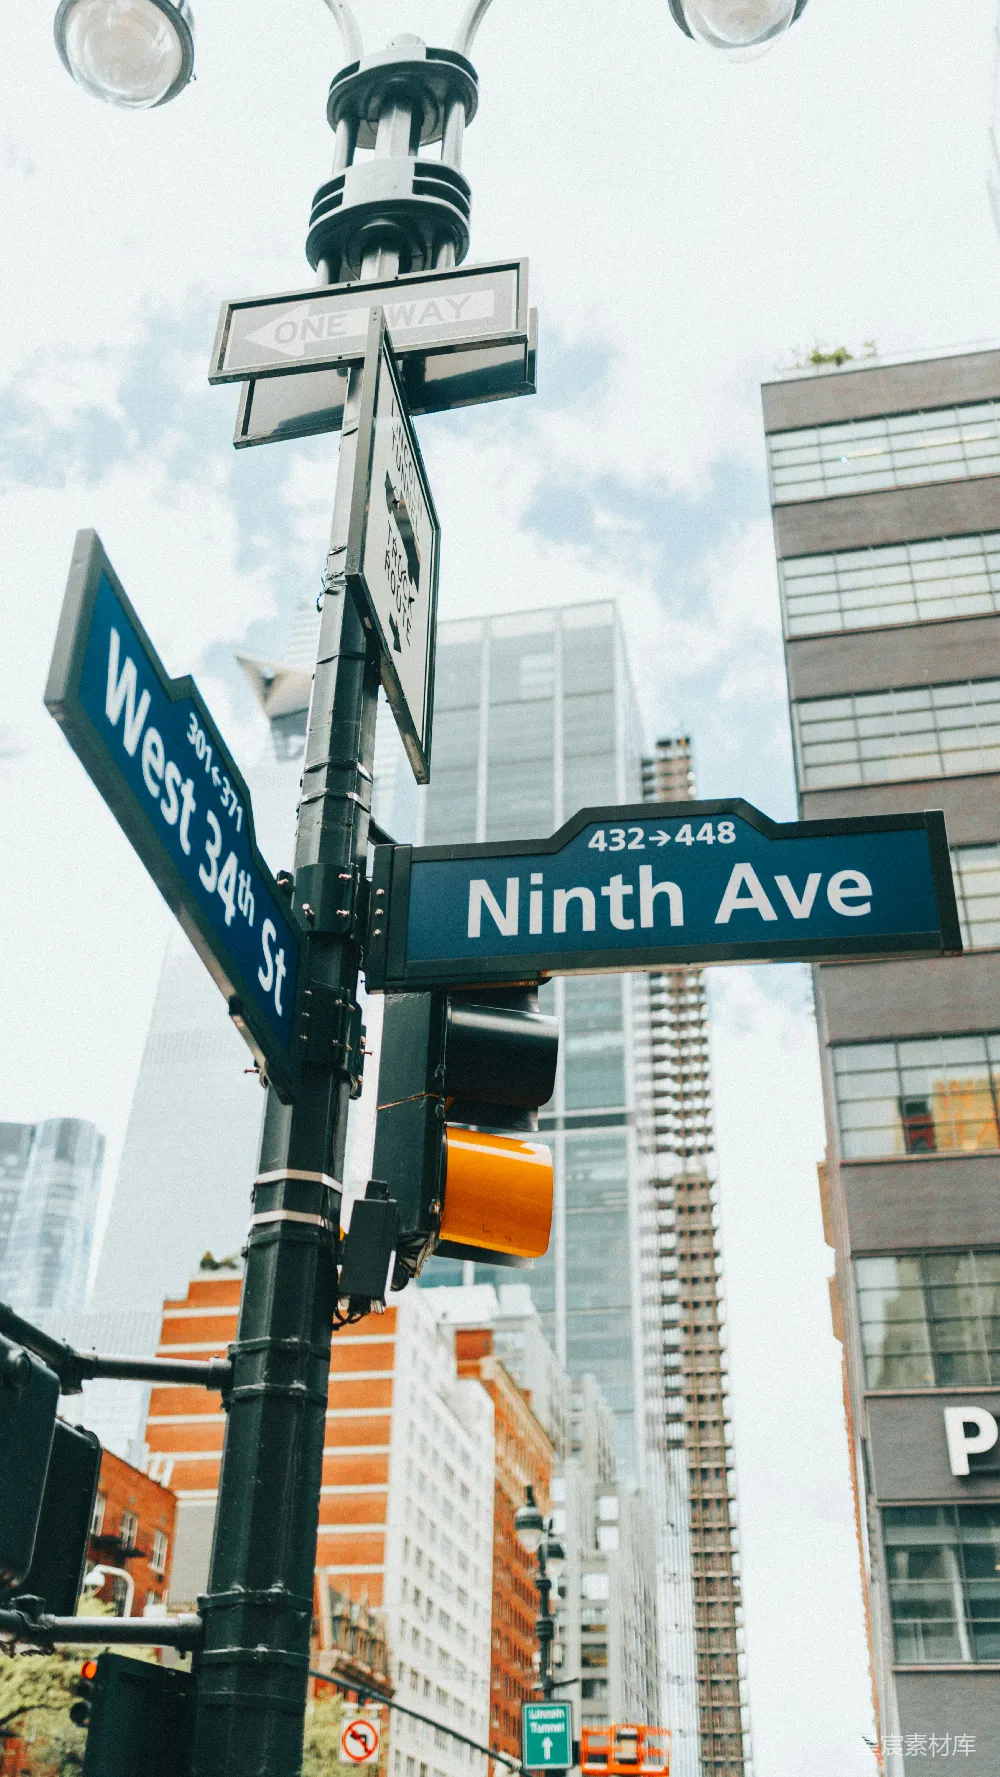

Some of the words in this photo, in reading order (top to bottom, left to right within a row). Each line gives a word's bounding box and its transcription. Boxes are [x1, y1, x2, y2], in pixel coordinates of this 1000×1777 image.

[275, 312, 347, 344] ONE
[388, 294, 471, 328] WAY
[384, 548, 411, 648] ROUTE
[387, 519, 413, 621] TRUCK
[186, 712, 213, 773] 301
[219, 776, 243, 833] 371
[105, 626, 197, 856] West
[199, 810, 255, 928] 34th
[258, 917, 287, 1018] St
[588, 827, 646, 852] 432
[674, 821, 737, 846] 448
[467, 864, 685, 938] Ninth
[714, 862, 874, 925] Ave
[943, 1406, 999, 1476] P
[528, 1708, 565, 1719] Lincoln
[529, 1722, 565, 1733] Tunnel
